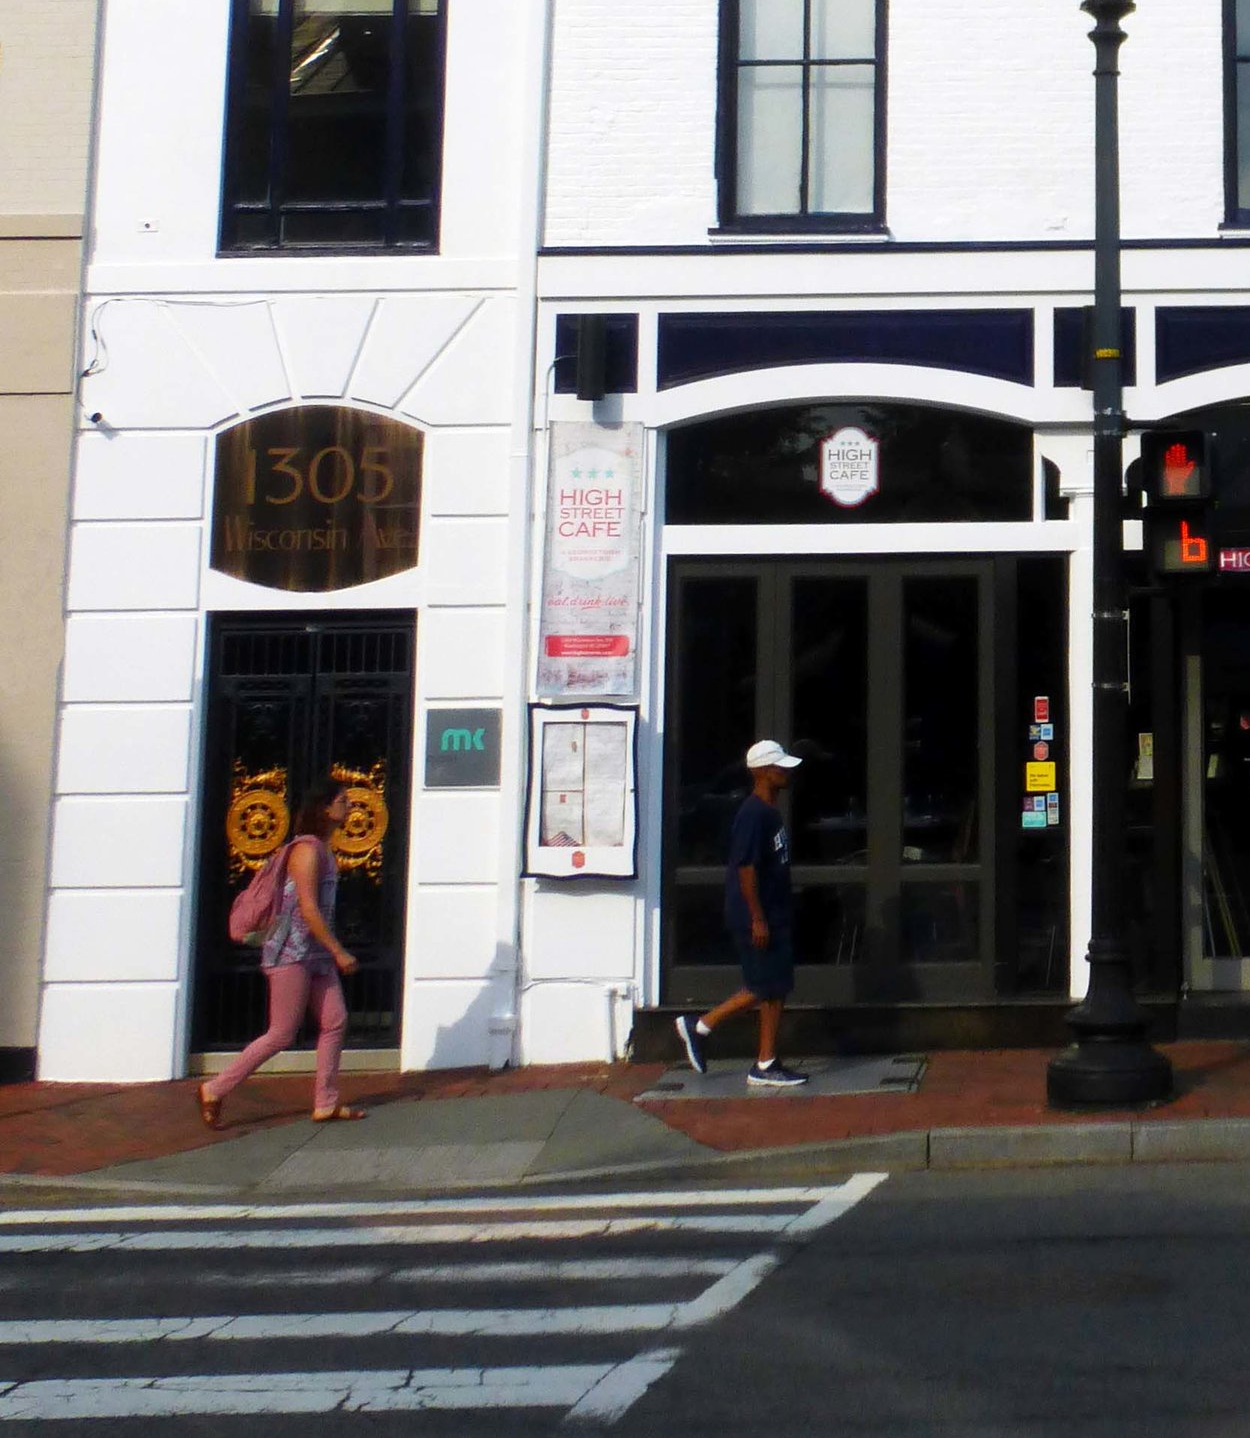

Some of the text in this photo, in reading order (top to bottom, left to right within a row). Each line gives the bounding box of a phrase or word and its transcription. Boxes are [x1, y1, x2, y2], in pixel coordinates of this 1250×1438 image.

[828, 448, 872, 461] HIGH
[830, 461, 869, 470] STREET
[244, 445, 395, 506] 1305
[829, 470, 869, 480] CAFE
[560, 489, 622, 505] HIGH
[560, 507, 625, 519] STREET
[558, 521, 621, 537] CAFE
